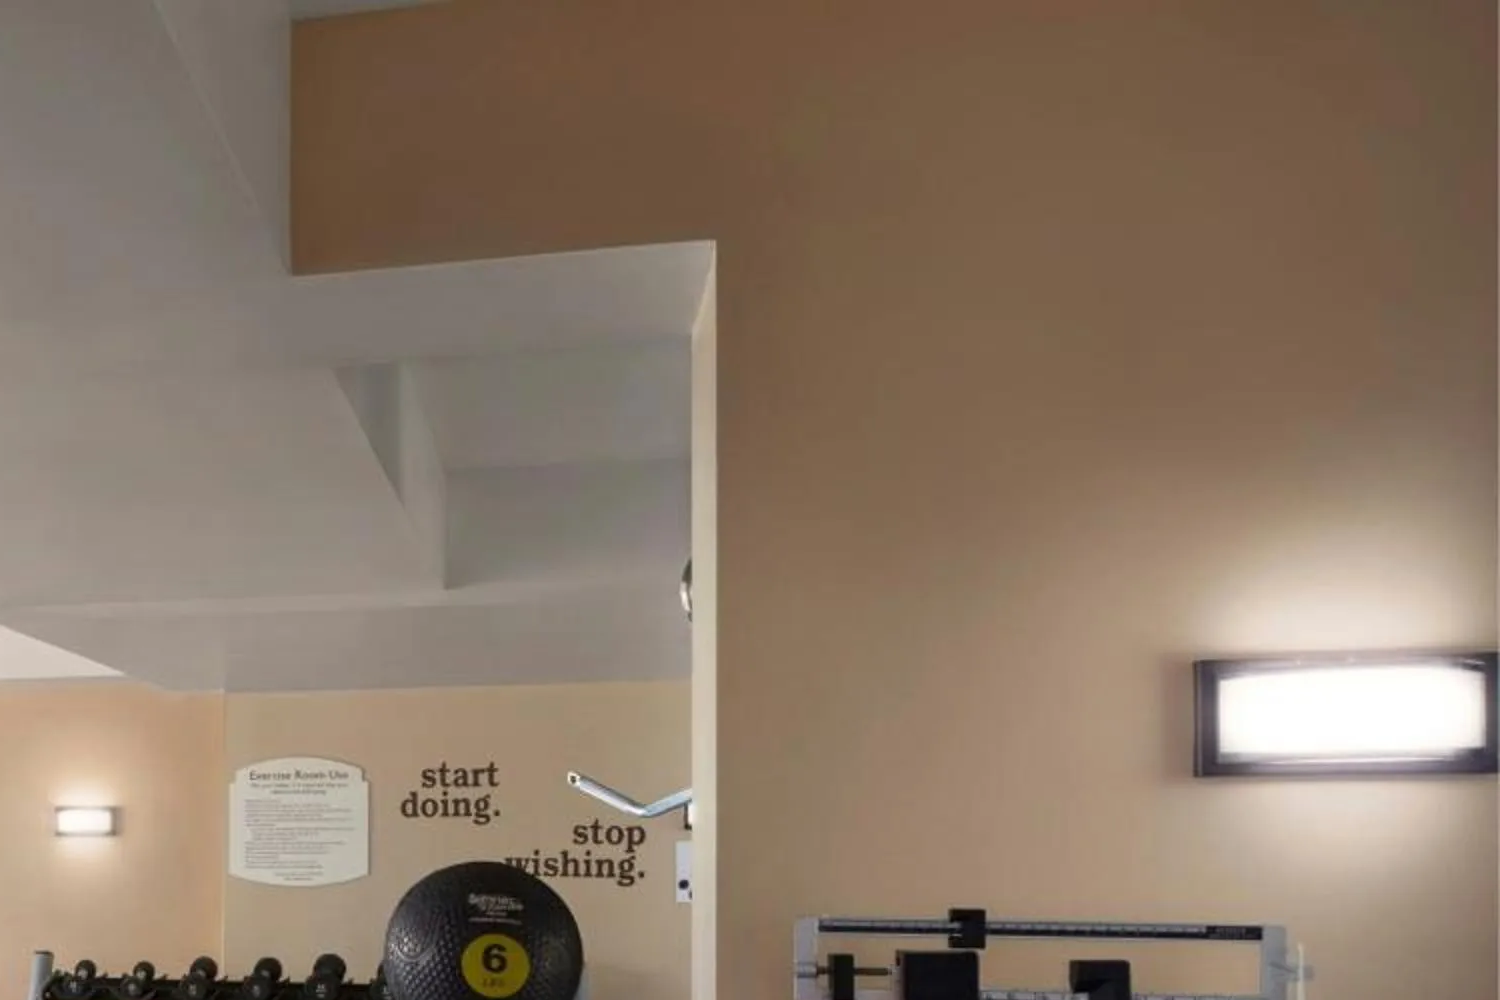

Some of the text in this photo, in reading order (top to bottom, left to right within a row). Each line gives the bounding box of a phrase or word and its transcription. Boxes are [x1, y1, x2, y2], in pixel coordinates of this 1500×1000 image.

[421, 760, 500, 788] start
[401, 790, 500, 825] doing.
[572, 818, 646, 852] stop
[504, 850, 646, 887] wishing.
[482, 943, 508, 975] 6
